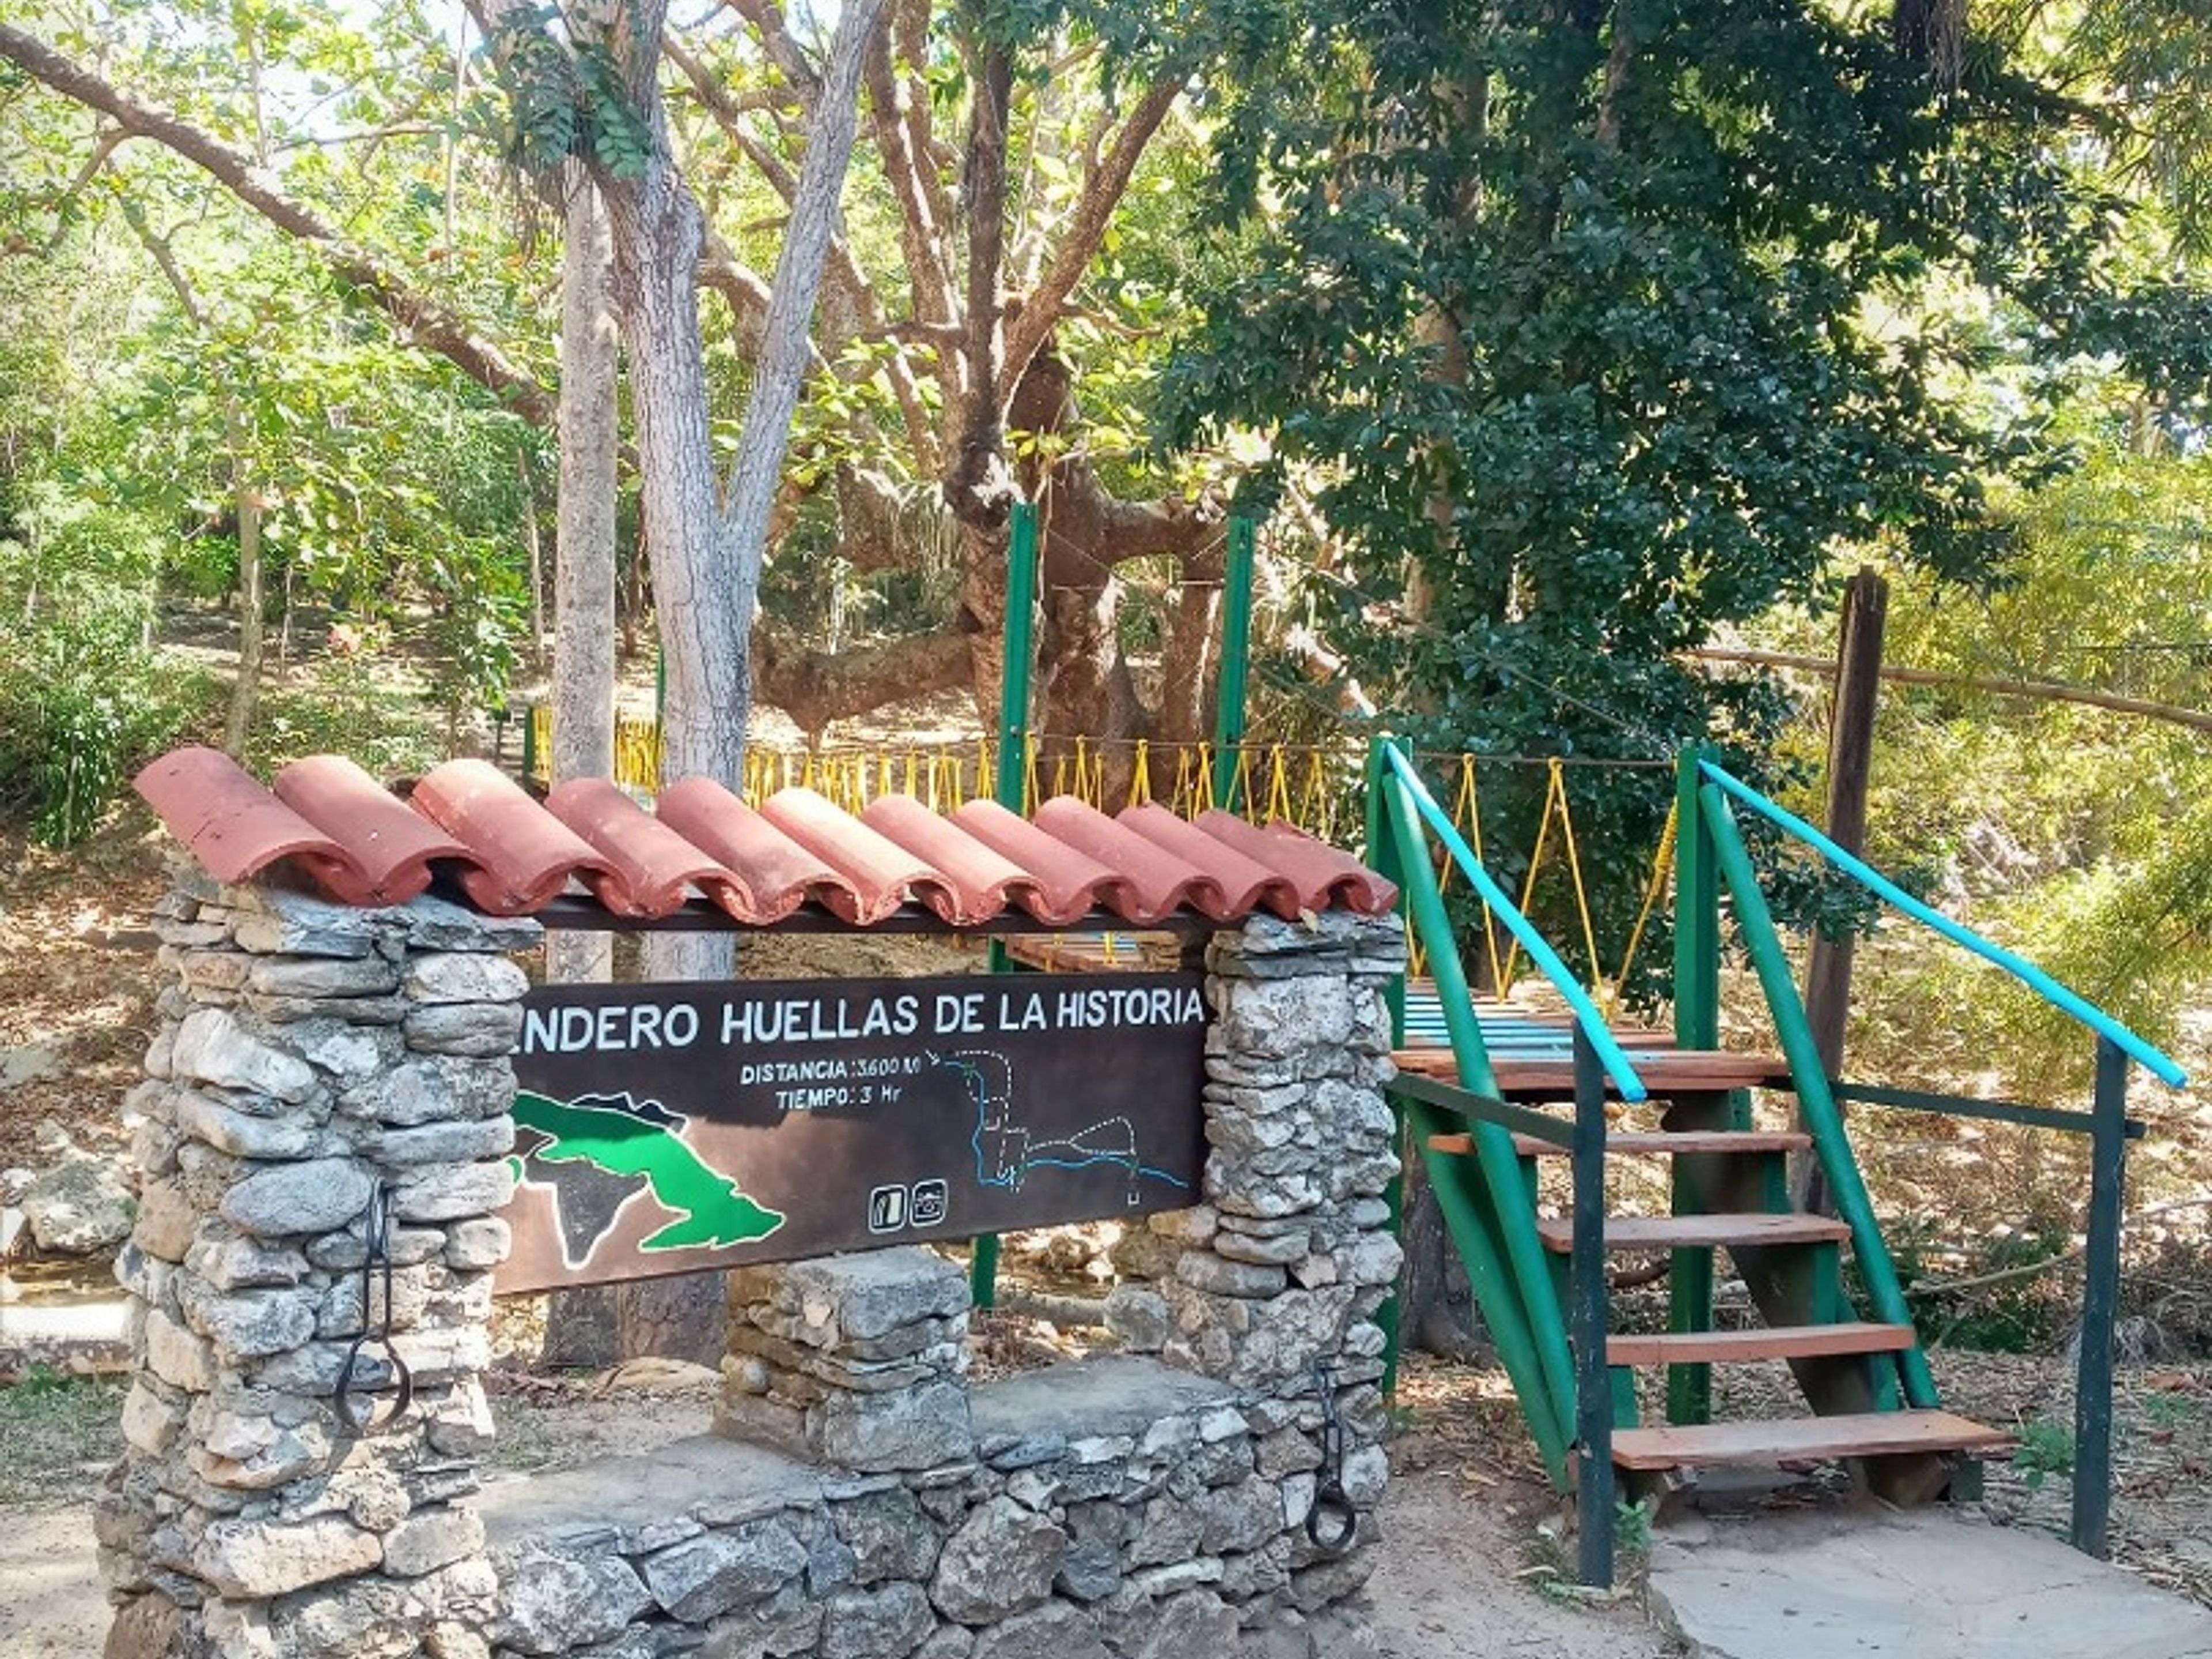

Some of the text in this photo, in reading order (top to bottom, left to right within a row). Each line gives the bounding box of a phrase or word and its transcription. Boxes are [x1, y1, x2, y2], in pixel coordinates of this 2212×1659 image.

[509, 987, 1205, 1054] NDERO HUELLAS DE LA HISTORIA
[860, 1086, 873, 1104] 3
[881, 1084, 902, 1103] Hr
